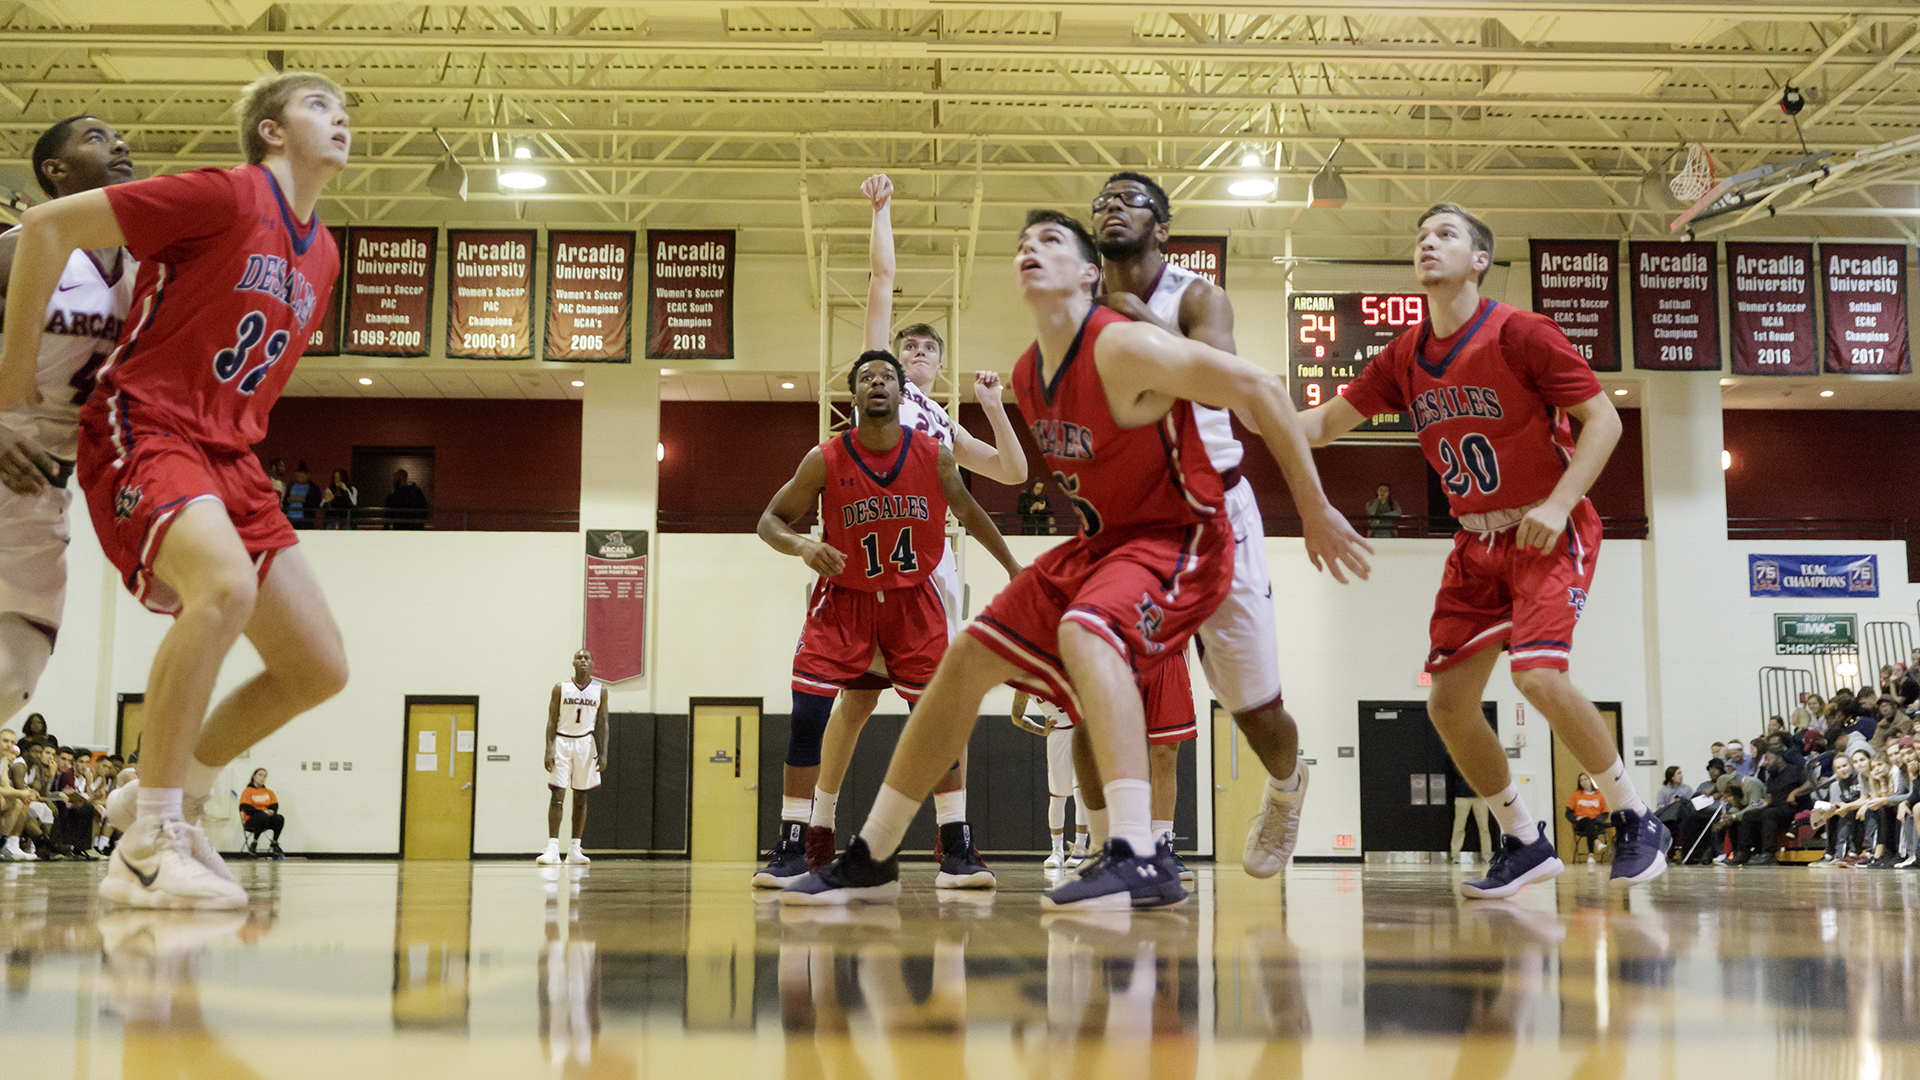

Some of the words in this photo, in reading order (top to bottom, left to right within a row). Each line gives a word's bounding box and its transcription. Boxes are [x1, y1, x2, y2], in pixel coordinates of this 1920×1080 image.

[358, 238, 427, 258] Arcadia
[456, 241, 526, 260] Arcadia
[556, 243, 625, 263] Arcadia
[656, 241, 726, 261] Arcadia
[356, 260, 426, 277] University
[1541, 252, 1609, 271] Arcadia
[1640, 252, 1708, 272] Arcadia
[1736, 254, 1805, 275] Arcadia
[1829, 255, 1898, 276] Arcadia
[456, 262, 525, 278] University
[556, 264, 624, 282] University
[656, 263, 725, 279] University
[356, 284, 392, 294] Women's
[394, 284, 424, 295] Soccer
[1541, 273, 1609, 291] University
[1640, 274, 1708, 291] University
[1736, 276, 1805, 294] University
[1829, 276, 1898, 295] University
[458, 287, 493, 297] Women's
[495, 287, 525, 297] Soccer
[556, 289, 592, 299] Women's
[594, 289, 623, 300] Soccer
[656, 287, 692, 298] Women's
[695, 288, 724, 298] Soccer
[381, 299, 397, 309] PAC
[483, 301, 500, 312] PAC
[558, 303, 574, 314] PAC
[576, 304, 619, 315] Champions
[667, 302, 687, 313] ECAC
[690, 302, 713, 313] South
[1294, 297, 1335, 311] ARCADIA
[1361, 296, 1423, 326] 5:09
[1542, 299, 1578, 308] Women's
[1580, 299, 1609, 309] Soccer
[1659, 299, 1691, 310] Softball
[1738, 302, 1775, 312] Women's
[1776, 302, 1806, 313] Soccer
[1849, 302, 1882, 313] Softball
[365, 313, 410, 325] Champions
[468, 316, 513, 328] Champions
[573, 318, 602, 328] NCAA's
[668, 316, 712, 328] Champions
[1554, 312, 1574, 322] ECAC
[1576, 312, 1599, 322] South
[1652, 313, 1673, 324] ECAC
[1675, 313, 1699, 324] South
[1761, 316, 1784, 327] NCAA
[1855, 316, 1877, 327] ECAC
[1300, 314, 1335, 343] 24
[1561, 327, 1598, 338] hampions
[1654, 328, 1698, 340] Champions
[352, 329, 421, 346] 1999-2000
[463, 333, 516, 349] 2000-01
[571, 335, 603, 350] 2005
[673, 334, 706, 350] 2013
[1753, 331, 1767, 342] 1st
[1769, 331, 1795, 342] Round
[1845, 331, 1889, 343] Champions
[213, 310, 290, 396] 32
[1660, 345, 1693, 362] 2016
[1757, 348, 1791, 365] 2016
[1851, 348, 1884, 365] 2017
[1297, 364, 1324, 377] fouls
[1306, 384, 1320, 406] 9
[1372, 413, 1400, 426] game
[1438, 433, 1500, 498] 20
[842, 496, 930, 528] DESALES
[861, 526, 919, 578] 14
[1756, 566, 1776, 579] 75
[1800, 564, 1827, 575] ECAC
[1852, 567, 1871, 580] 75
[1783, 576, 1847, 588] CHAMPIONS
[563, 698, 597, 706] ARCADIA
[575, 708, 581, 723] 1
